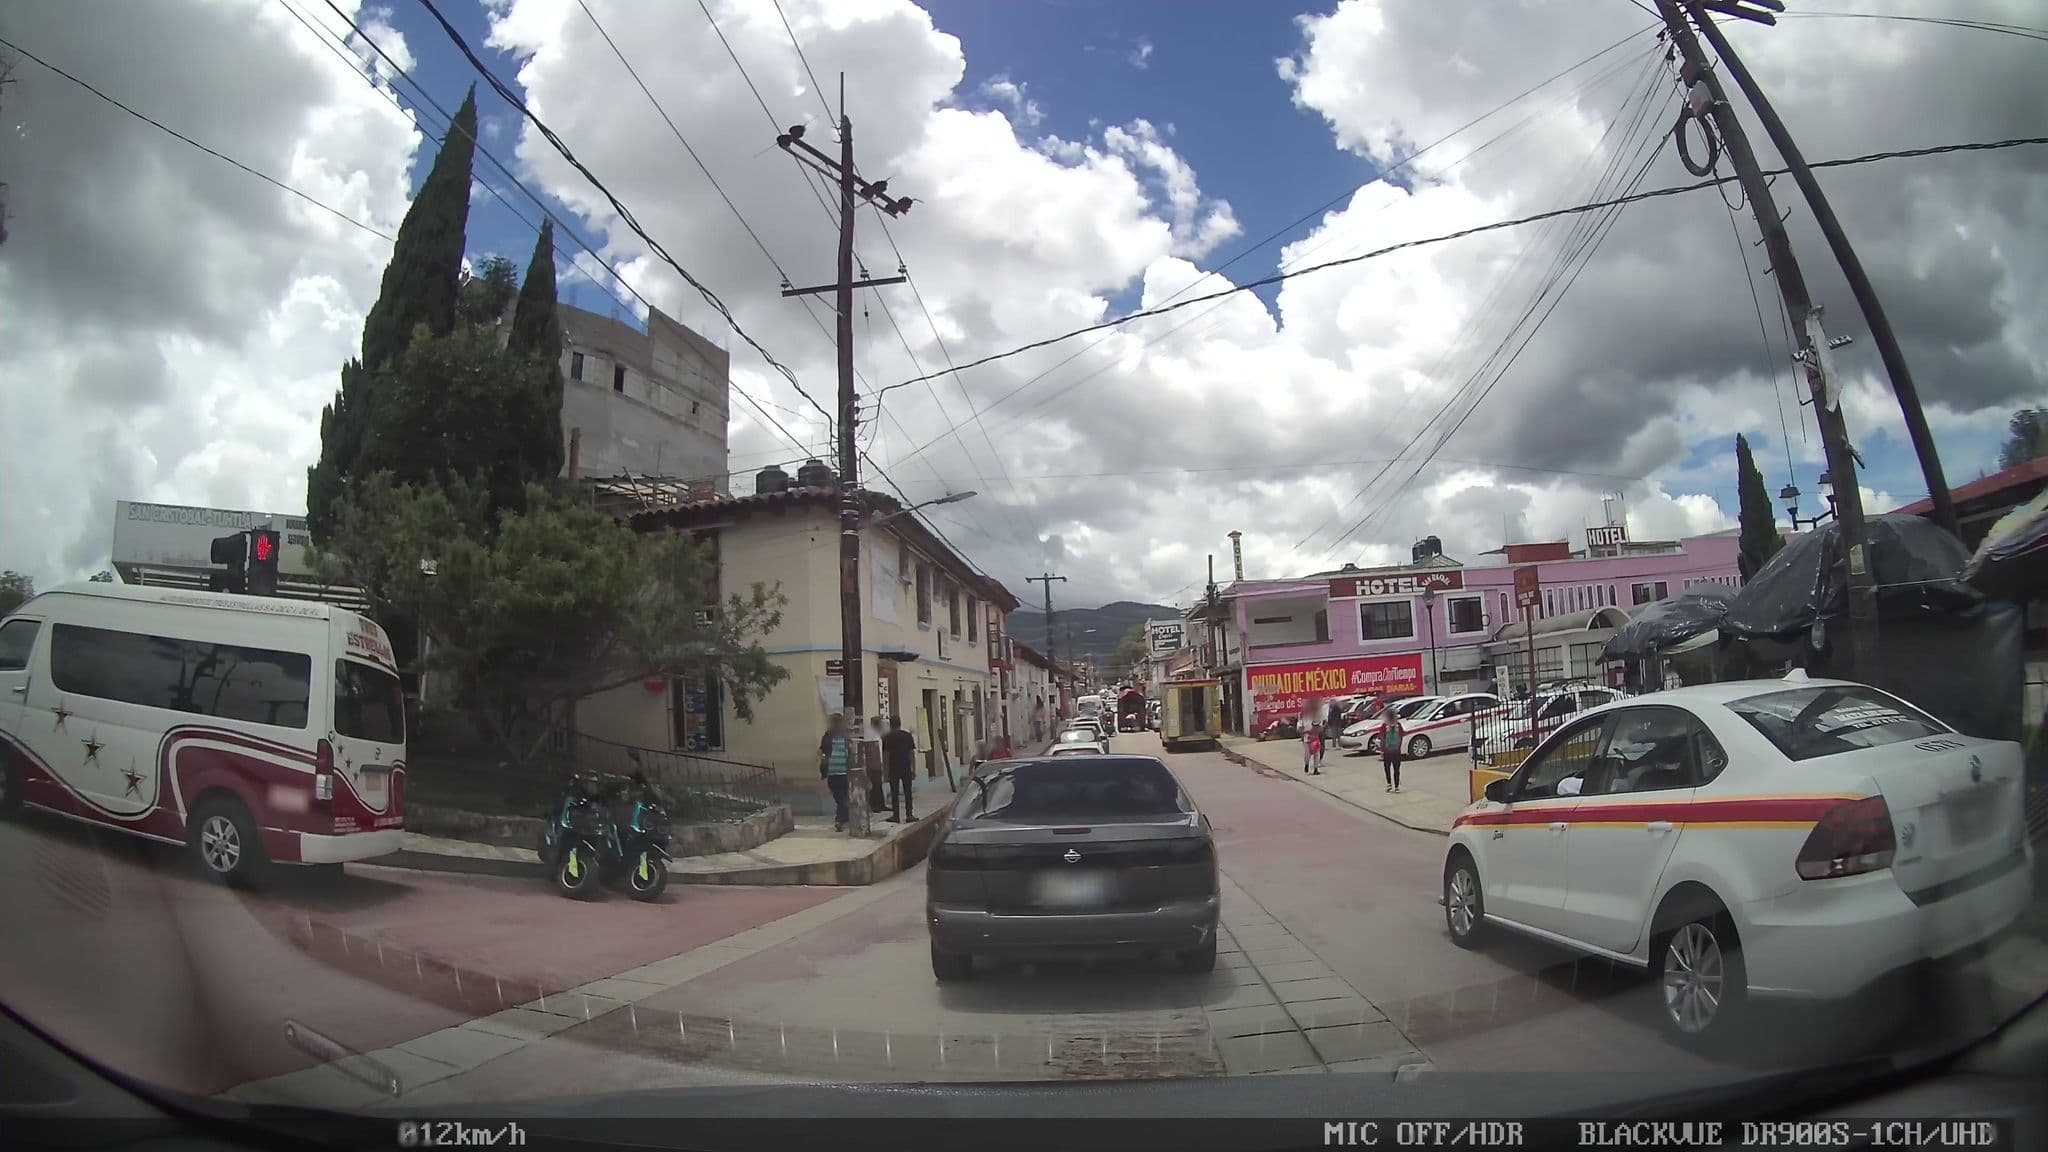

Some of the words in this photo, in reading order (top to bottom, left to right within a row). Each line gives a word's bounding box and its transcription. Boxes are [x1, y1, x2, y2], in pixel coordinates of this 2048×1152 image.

[129, 503, 150, 521] SAN
[1588, 528, 1626, 545] HOTEL
[1356, 577, 1426, 595] HOTEL
[1152, 626, 1181, 634] HOTEL
[1293, 672, 1304, 693] DE
[1305, 667, 1347, 692] MÉXICO
[1287, 699, 1295, 708] de
